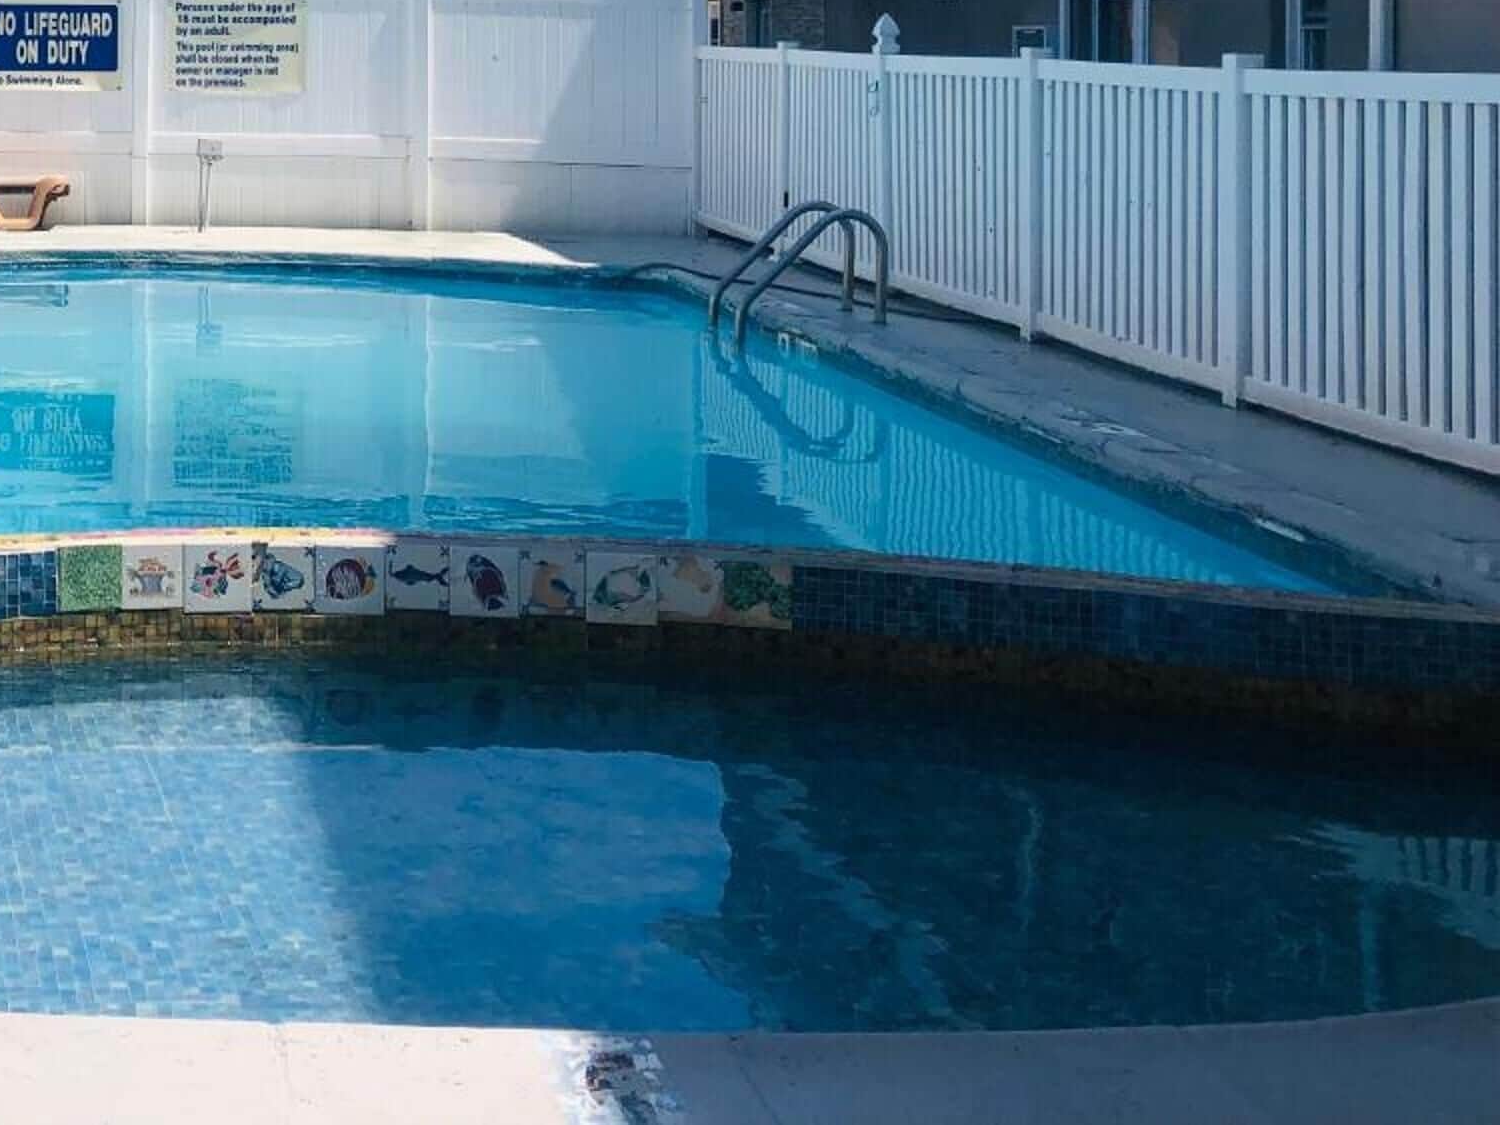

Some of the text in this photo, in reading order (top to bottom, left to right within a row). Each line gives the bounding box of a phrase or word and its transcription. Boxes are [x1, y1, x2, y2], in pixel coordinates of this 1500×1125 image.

[175, 2, 296, 15] Persons under the age of
[25, 11, 113, 37] LIFEGUARD
[191, 15, 216, 24] must
[218, 15, 229, 24] be
[232, 15, 297, 26] accompanied
[175, 26, 232, 37] by an adult.
[16, 39, 90, 65] ON DUTY
[176, 42, 194, 52] This
[196, 42, 215, 54] pool
[231, 43, 274, 54] swimming
[276, 42, 299, 54] area)
[175, 54, 279, 64] shall be closed when the
[175, 66, 279, 77] owner or manager is not
[6, 75, 53, 87] Swimming
[175, 79, 187, 87] on
[188, 78, 203, 87] the
